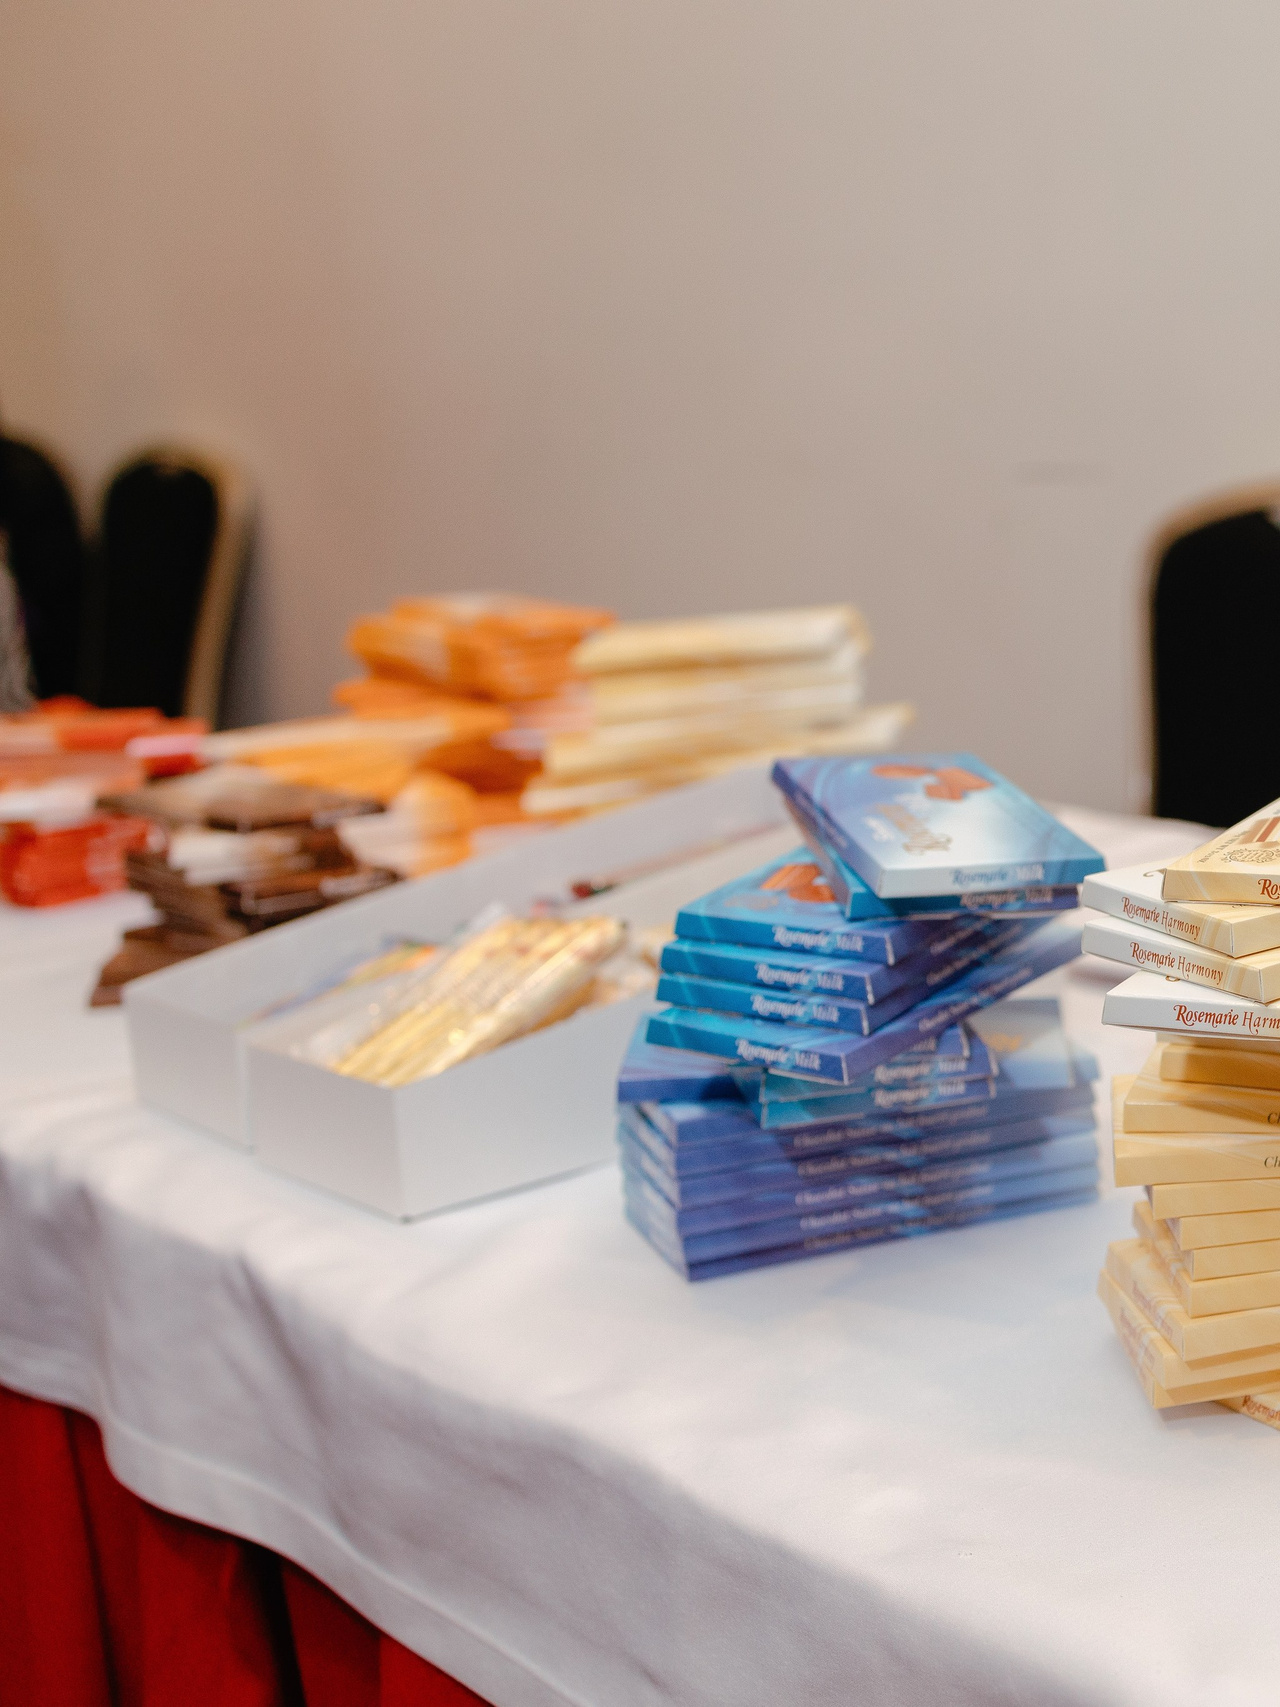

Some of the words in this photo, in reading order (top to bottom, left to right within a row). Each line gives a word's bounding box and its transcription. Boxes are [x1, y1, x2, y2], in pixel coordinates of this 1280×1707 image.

[1121, 897, 1160, 924] Rosemarie
[1161, 911, 1201, 941] Harmony
[1129, 941, 1176, 972] Rosemarie
[1177, 956, 1224, 986] Harmony
[1173, 1004, 1239, 1026] Rosemarie
